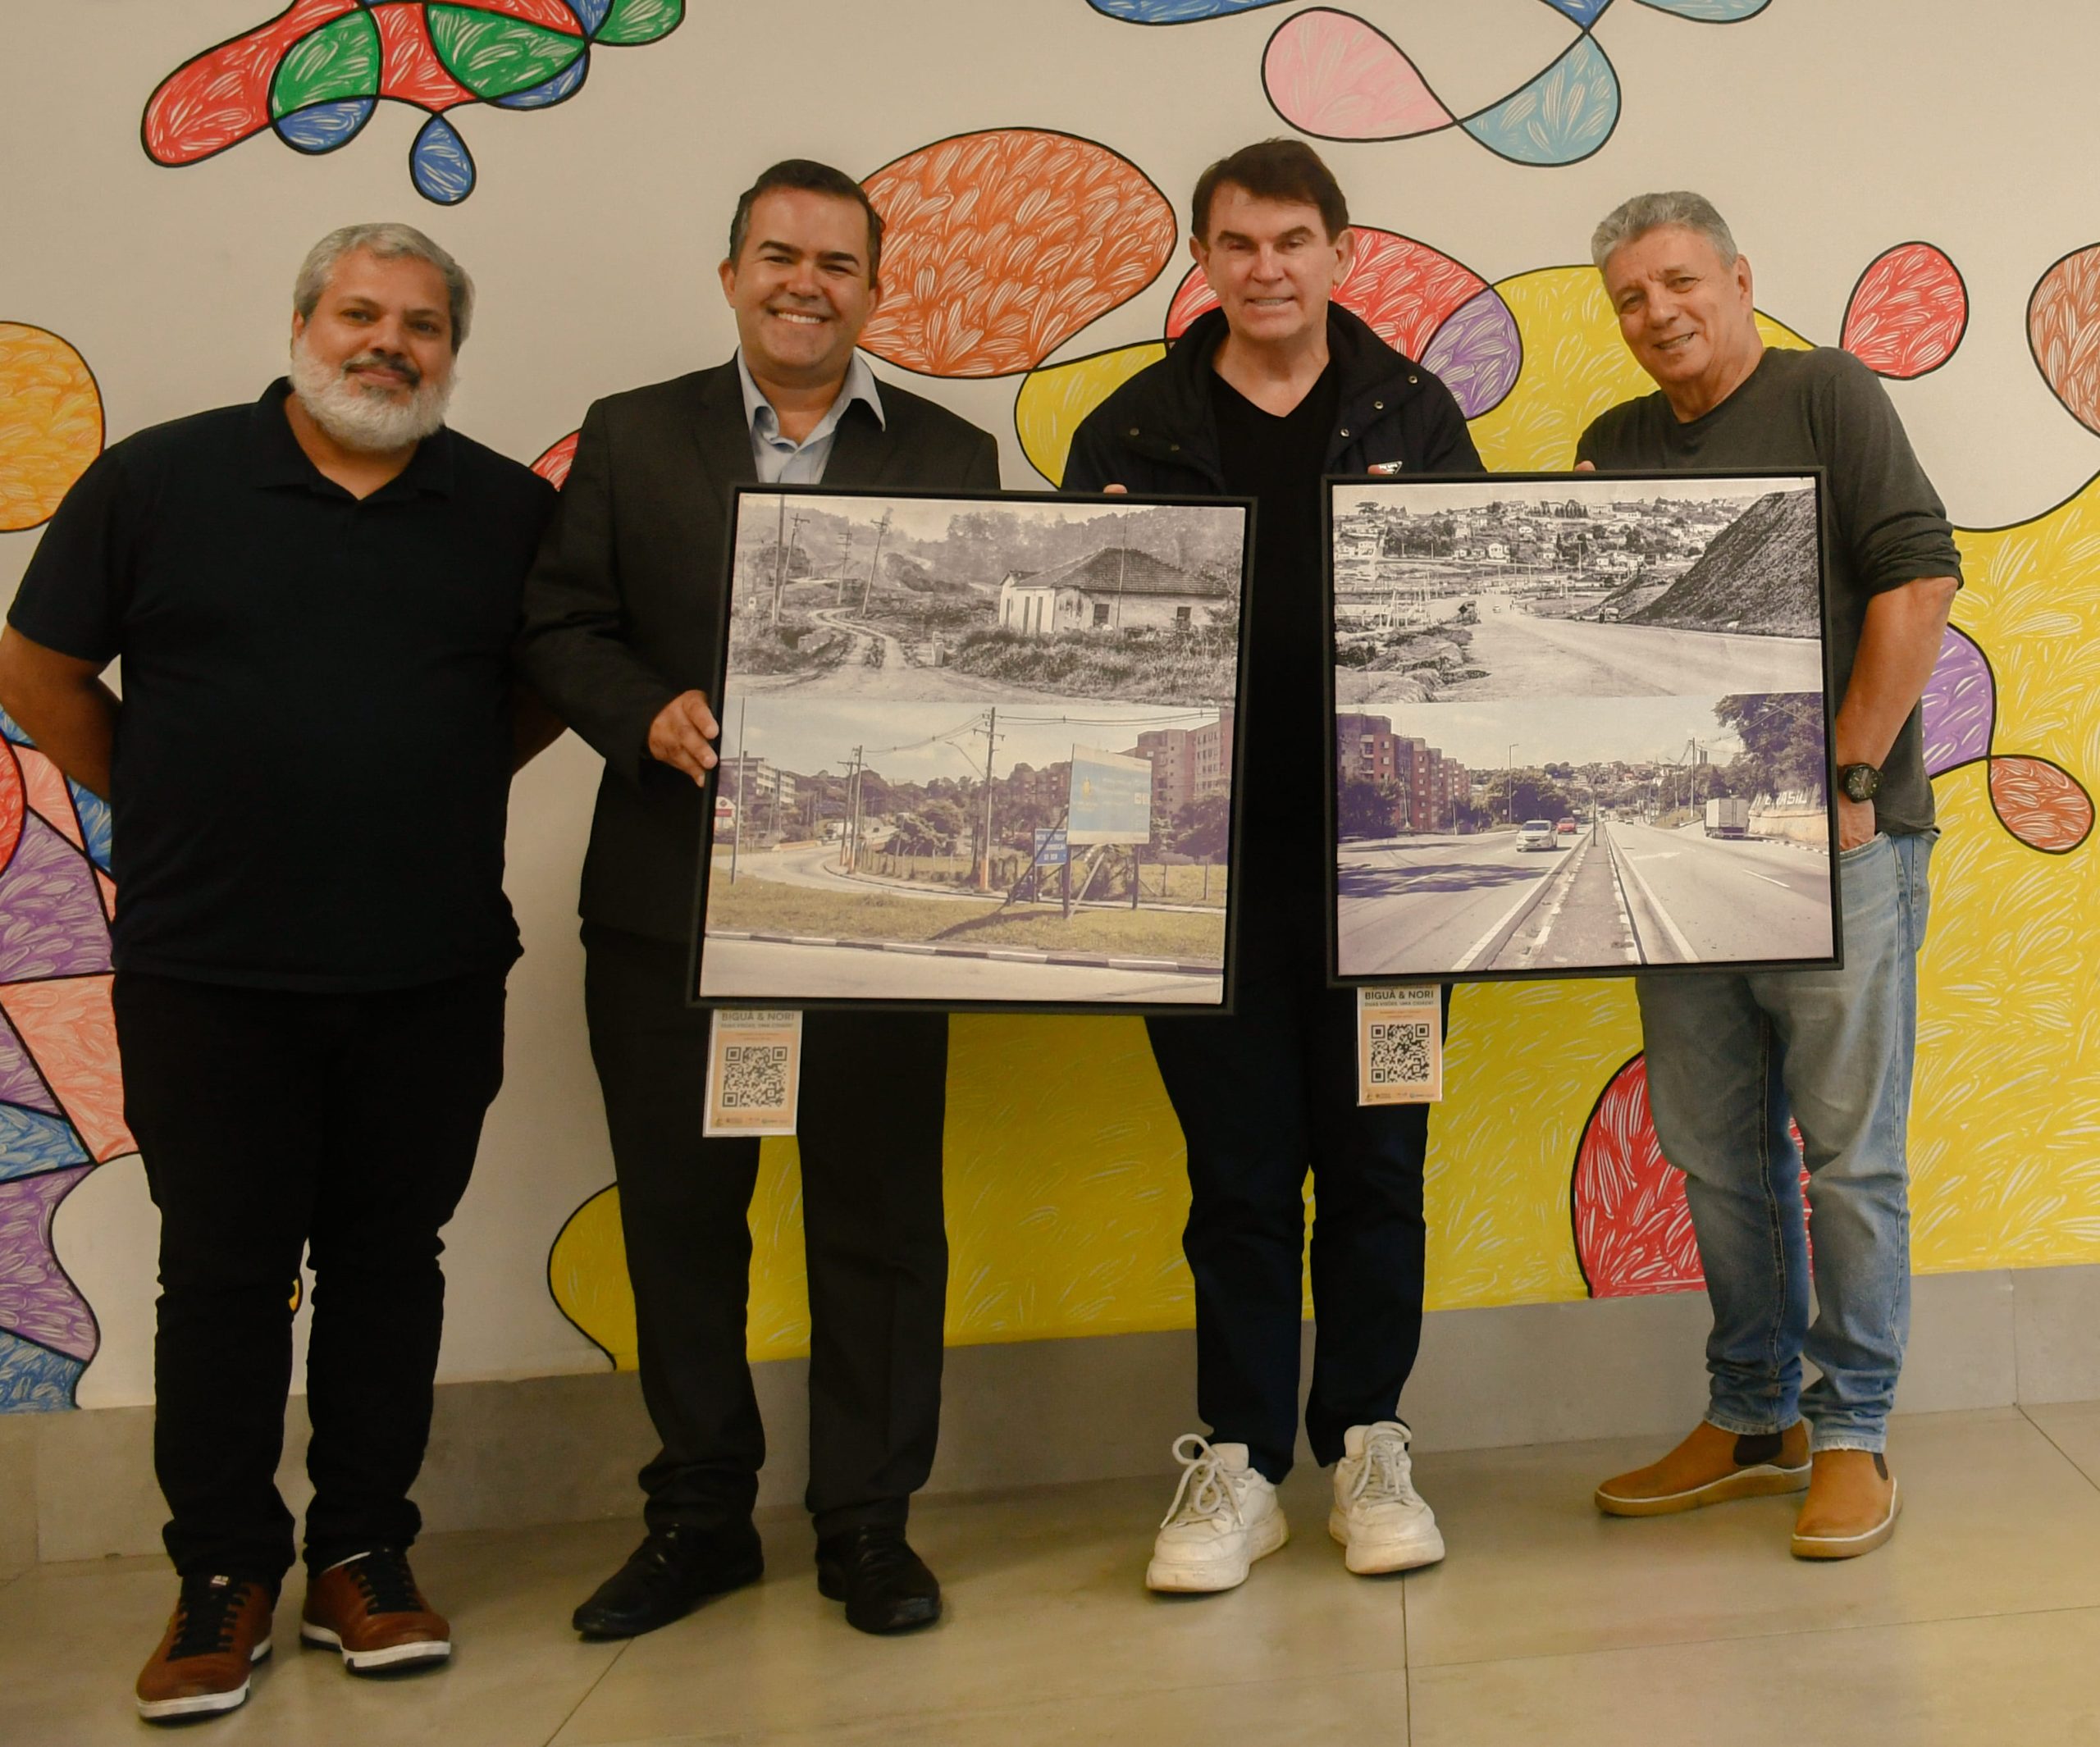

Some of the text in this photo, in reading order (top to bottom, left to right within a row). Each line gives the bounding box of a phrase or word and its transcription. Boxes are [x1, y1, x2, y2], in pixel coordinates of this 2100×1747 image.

[1399, 991, 1405, 1000] &
[1408, 990, 1434, 999] NORI
[757, 1012, 765, 1021] &
[767, 1012, 794, 1021] NORI
